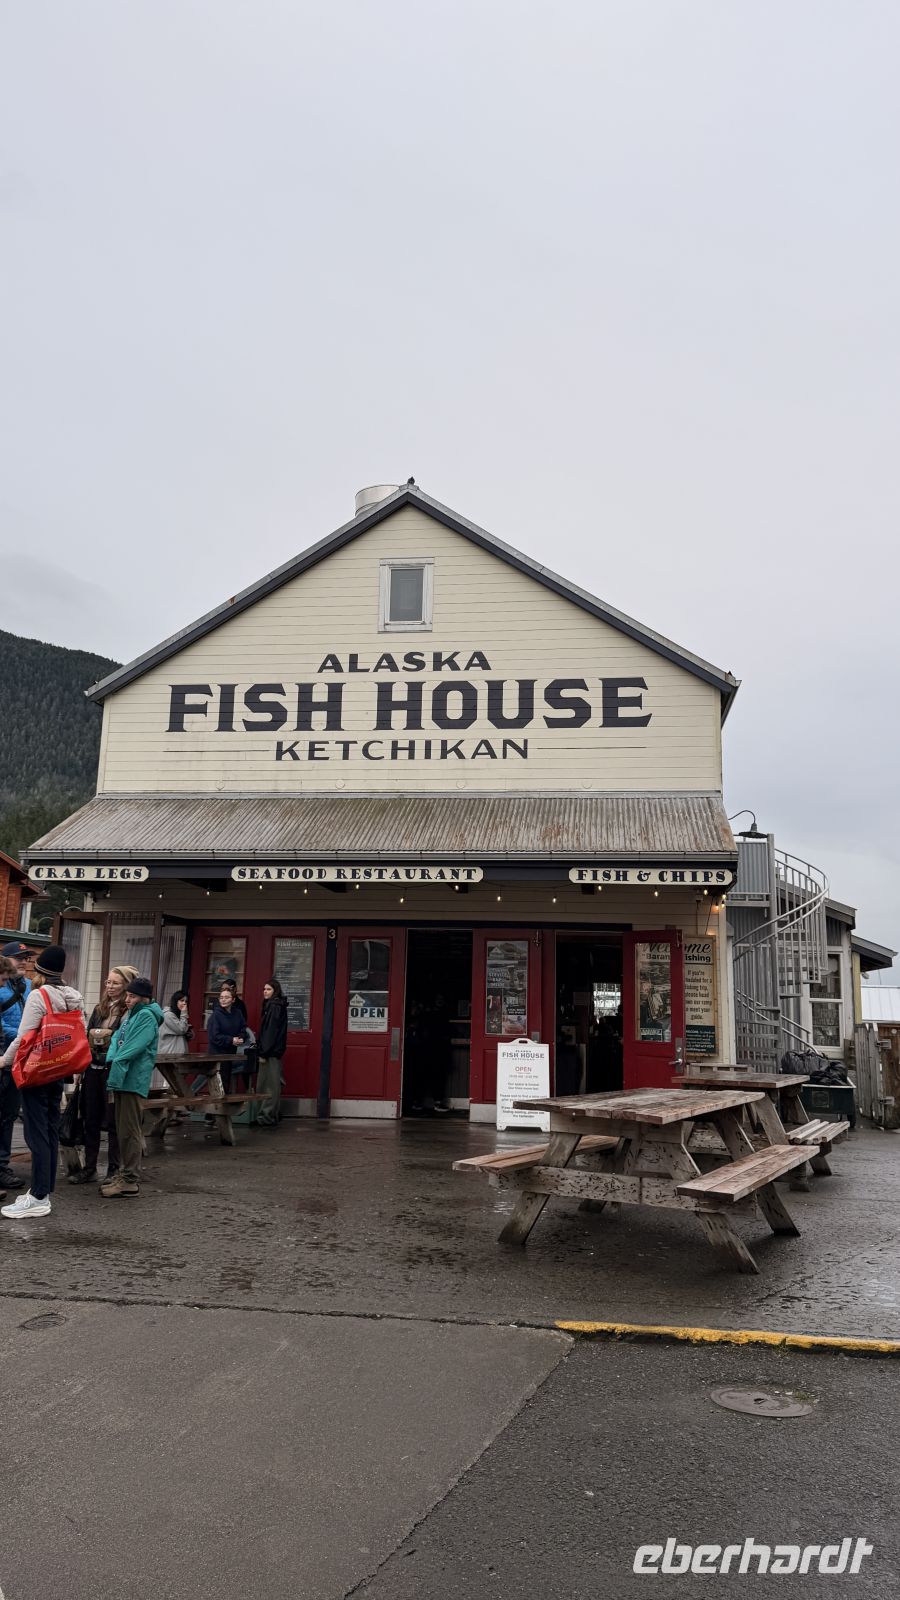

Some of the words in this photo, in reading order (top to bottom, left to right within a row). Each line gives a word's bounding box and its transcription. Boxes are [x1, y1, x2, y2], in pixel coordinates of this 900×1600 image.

[317, 651, 491, 674] ALASKA
[165, 682, 347, 733] FISH
[372, 677, 653, 731] HOUSE
[276, 739, 529, 762] KETCHIKAN
[34, 867, 85, 880] CRAB
[94, 867, 143, 880] LEGS
[237, 867, 327, 880] SEAFOOD
[335, 868, 477, 881] RESTAURANT
[576, 869, 629, 882] FISH
[636, 870, 651, 883] &
[658, 870, 727, 884] CHIPS
[328, 928, 336, 938] 3
[351, 1008, 385, 1018] OPEN
